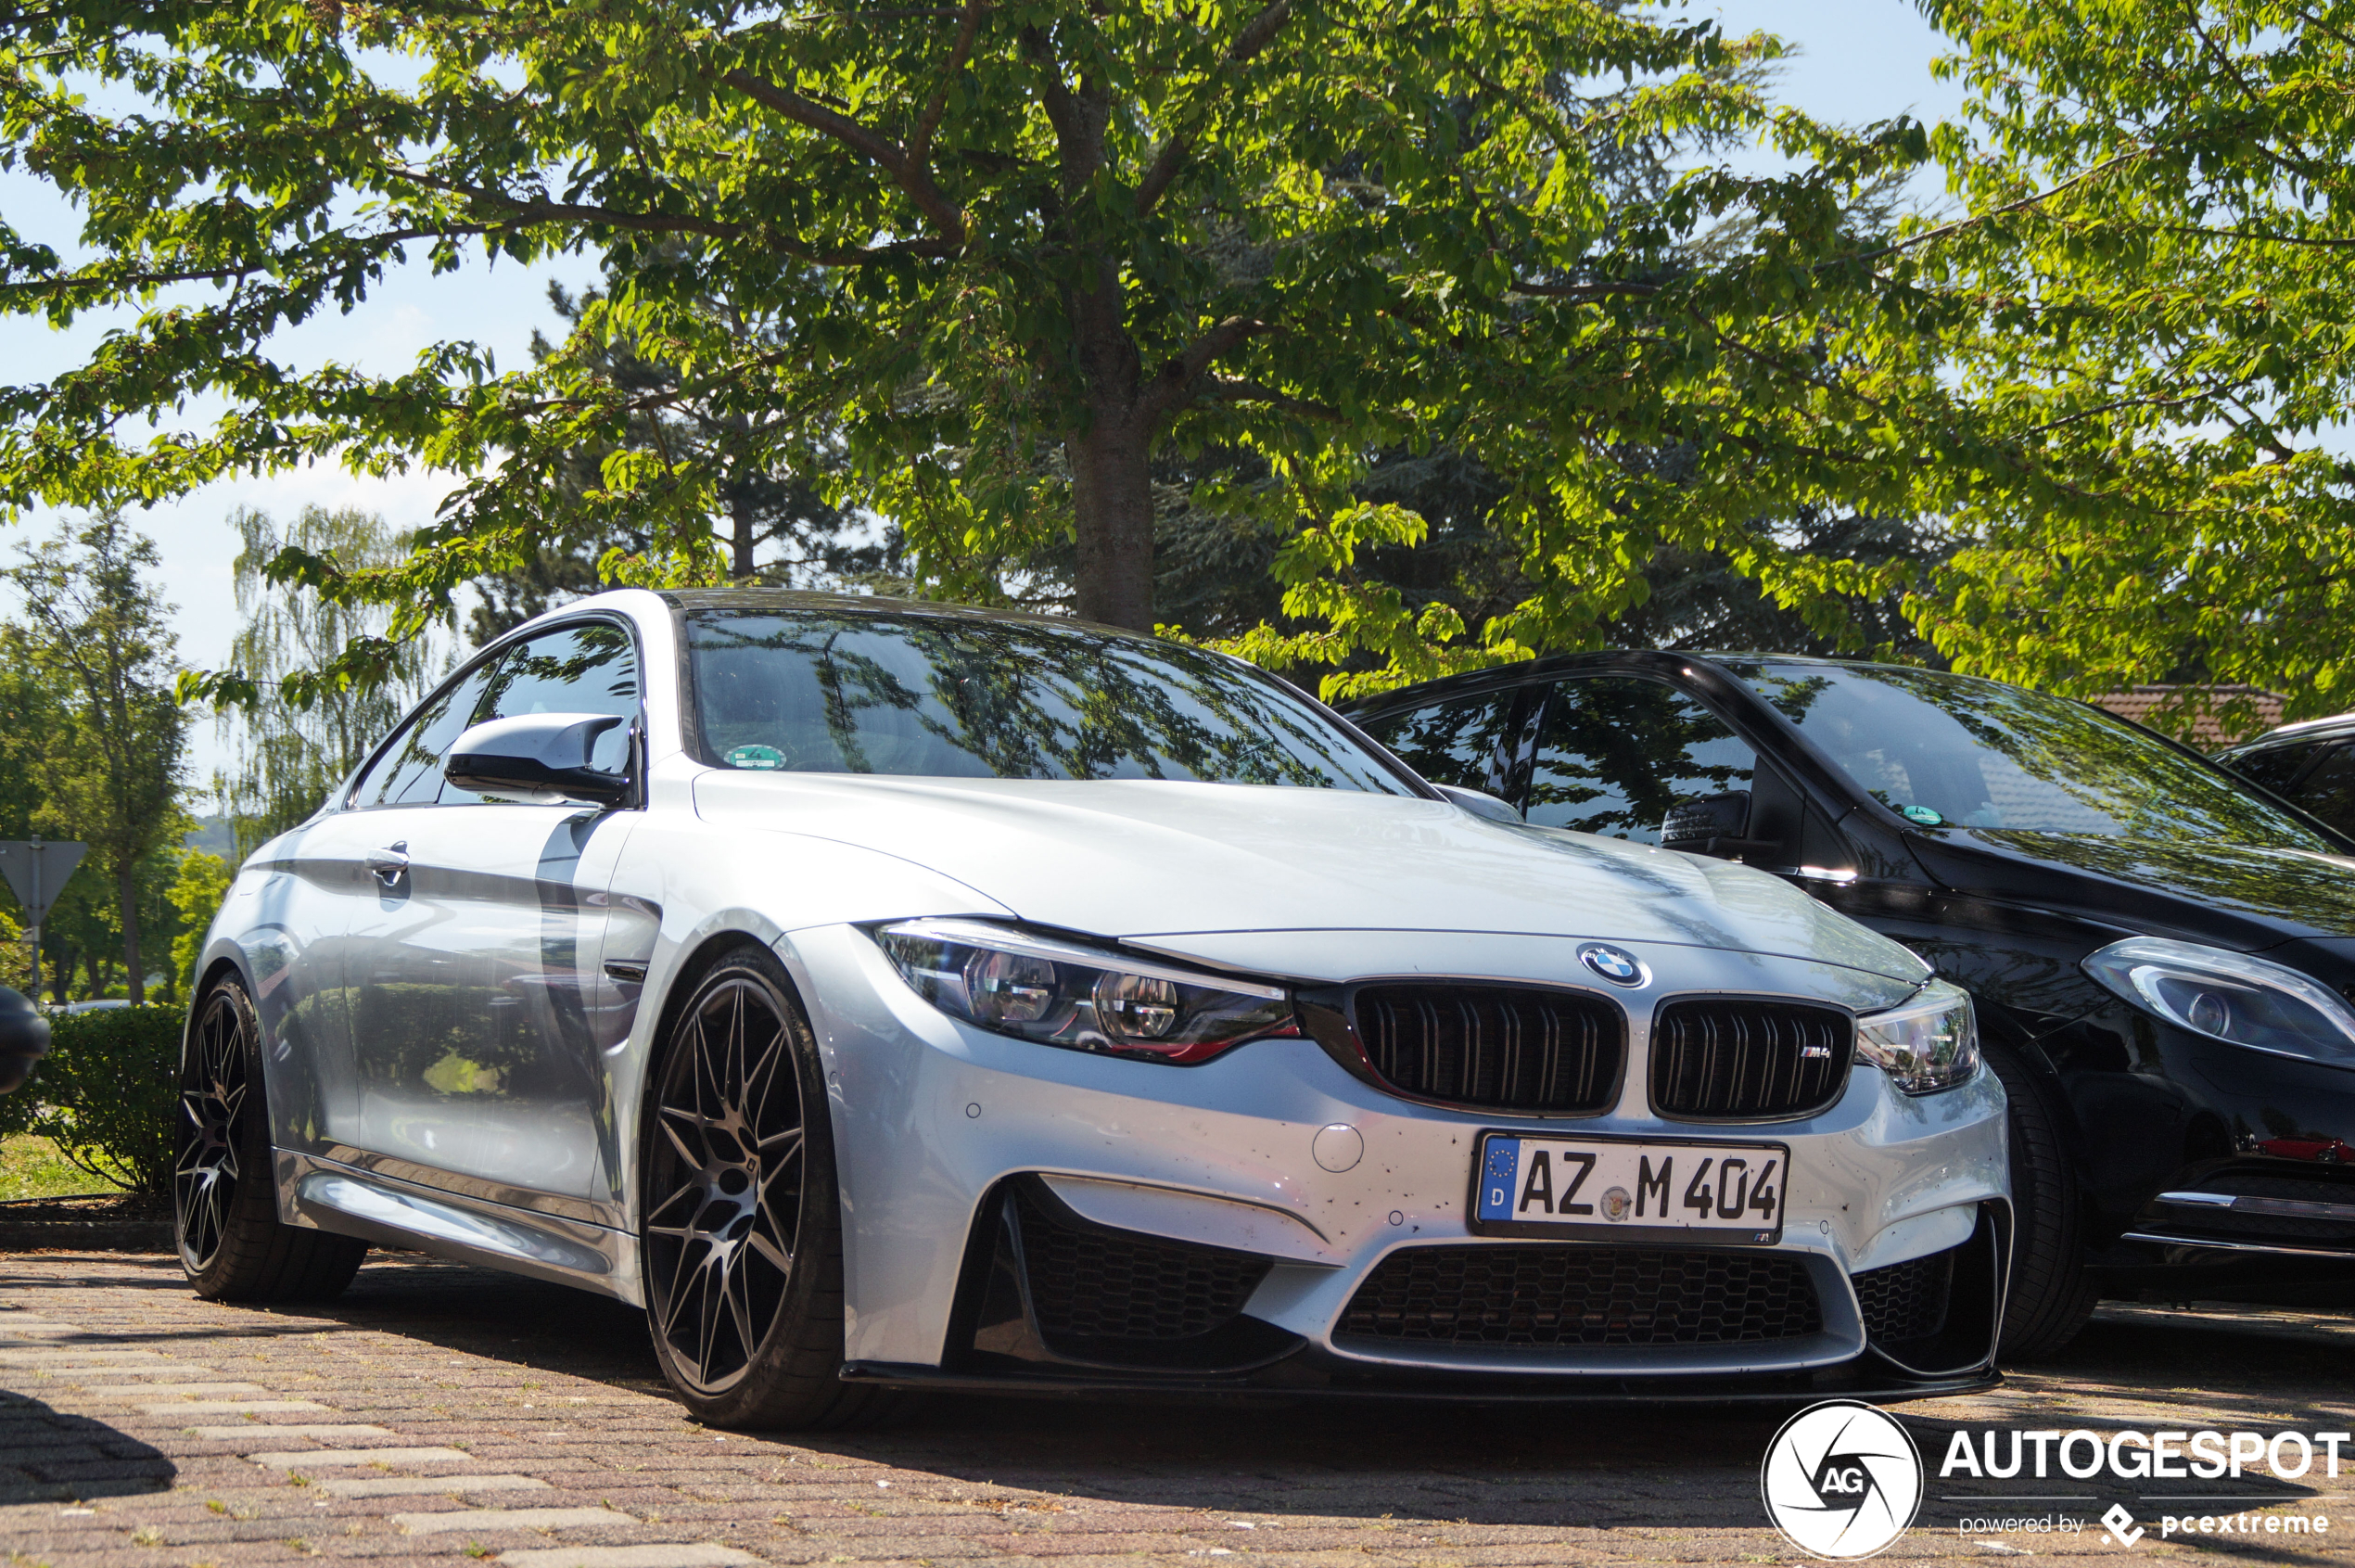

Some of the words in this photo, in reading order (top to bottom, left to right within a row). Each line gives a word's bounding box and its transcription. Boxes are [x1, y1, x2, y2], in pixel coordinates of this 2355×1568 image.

[747, 748, 762, 759] 4
[1806, 1046, 1831, 1058] M4
[1519, 1150, 1597, 1216] AZ
[1635, 1155, 1673, 1218] M
[1684, 1157, 1777, 1220] 404
[1491, 1188, 1505, 1206] D
